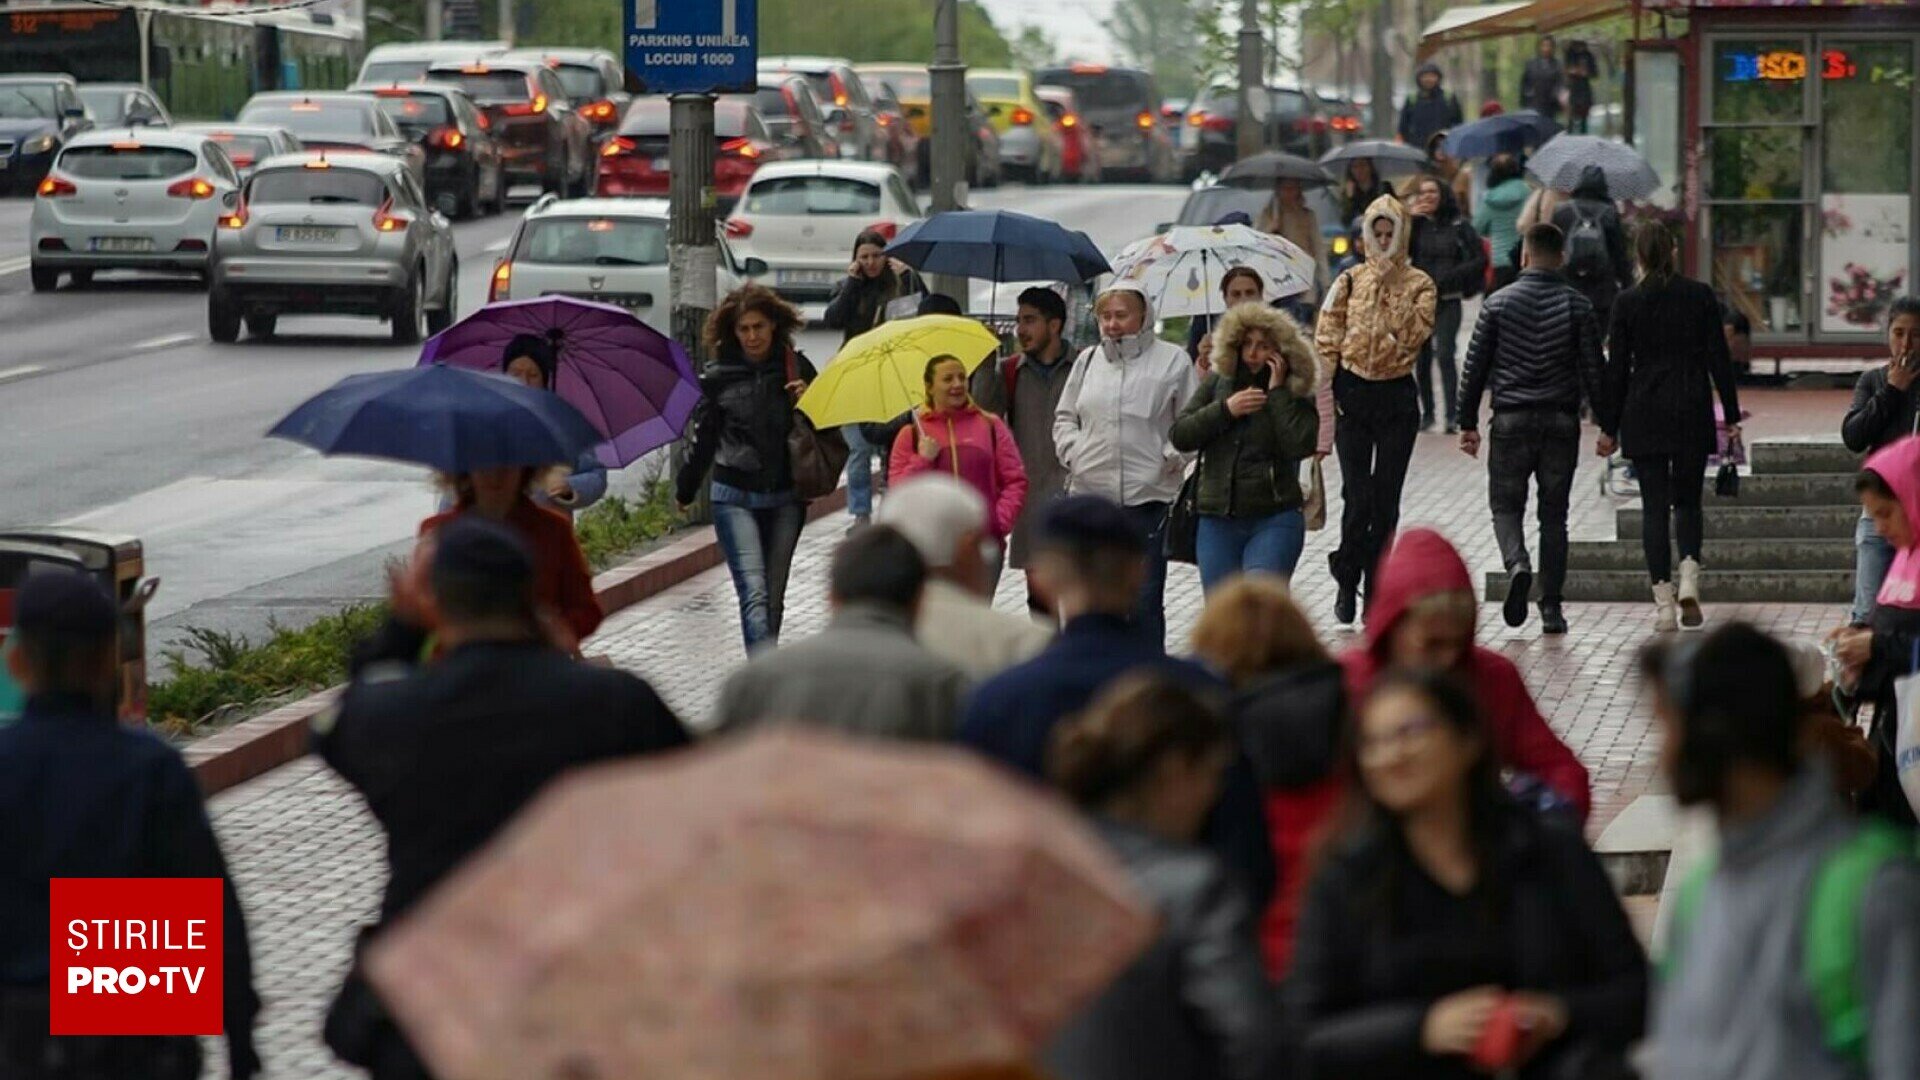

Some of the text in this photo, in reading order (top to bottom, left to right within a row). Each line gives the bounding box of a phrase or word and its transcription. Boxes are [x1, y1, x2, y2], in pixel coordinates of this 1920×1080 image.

[629, 34, 749, 47] PARKING UNIREA
[644, 53, 734, 65] LOCURI 1000
